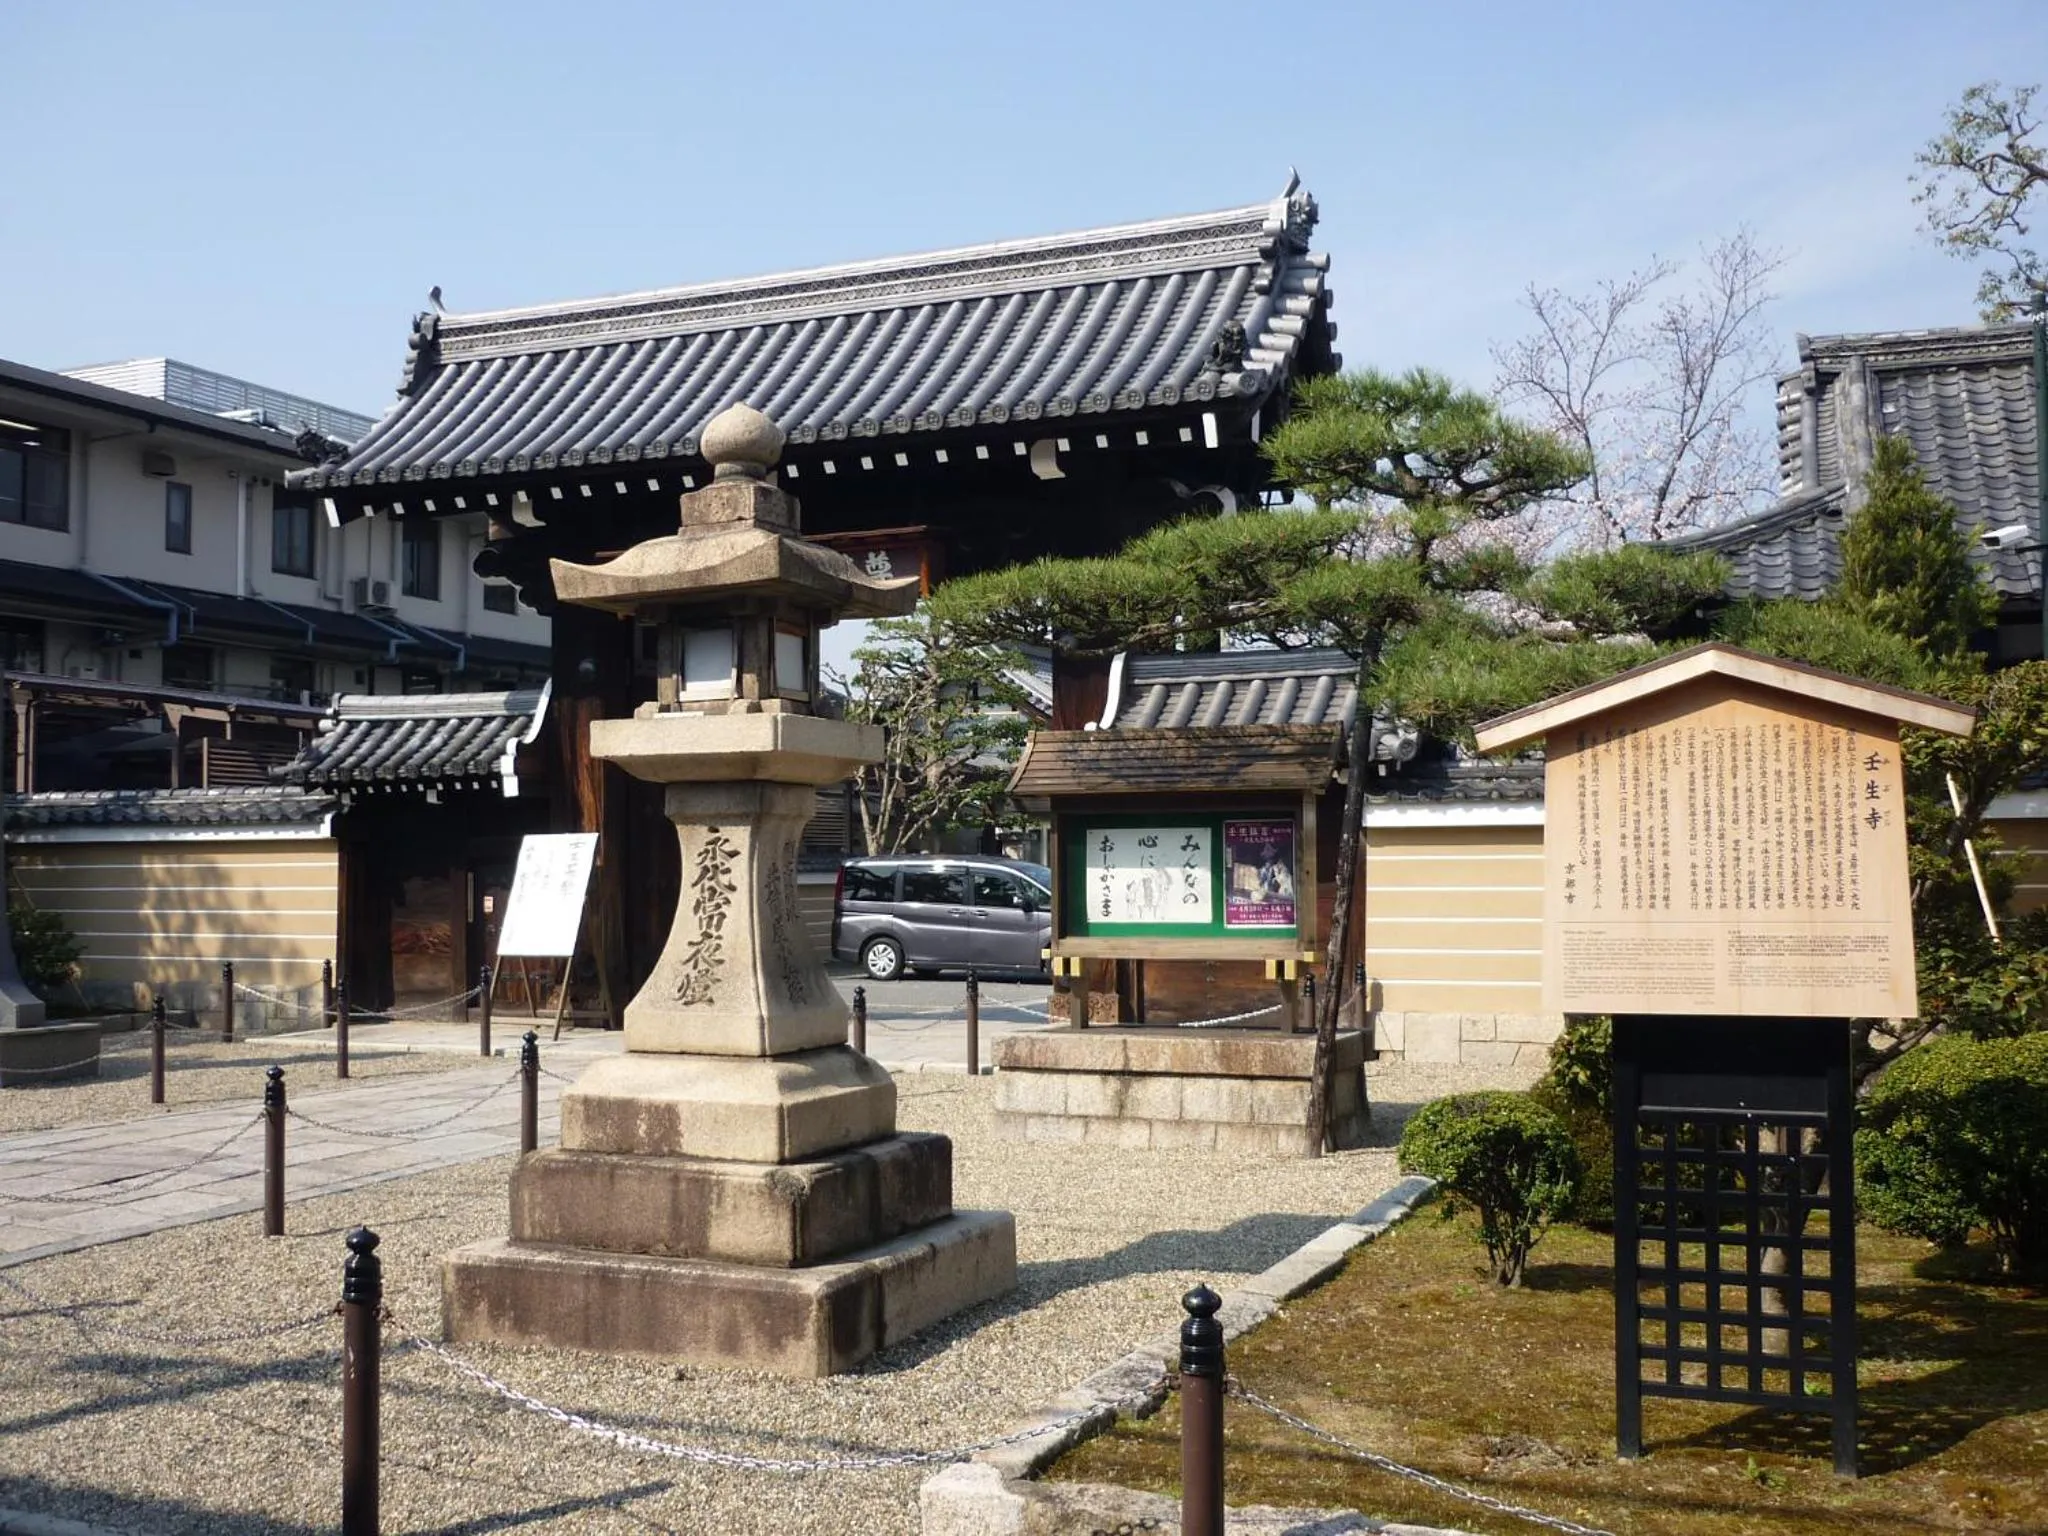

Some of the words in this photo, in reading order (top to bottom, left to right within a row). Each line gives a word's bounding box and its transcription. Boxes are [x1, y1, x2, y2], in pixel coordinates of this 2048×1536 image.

[1862, 751, 1882, 830] 壬生寺
[1138, 835, 1159, 868] 心に
[1180, 834, 1201, 904] みんなの
[1564, 862, 1577, 905] 京都市
